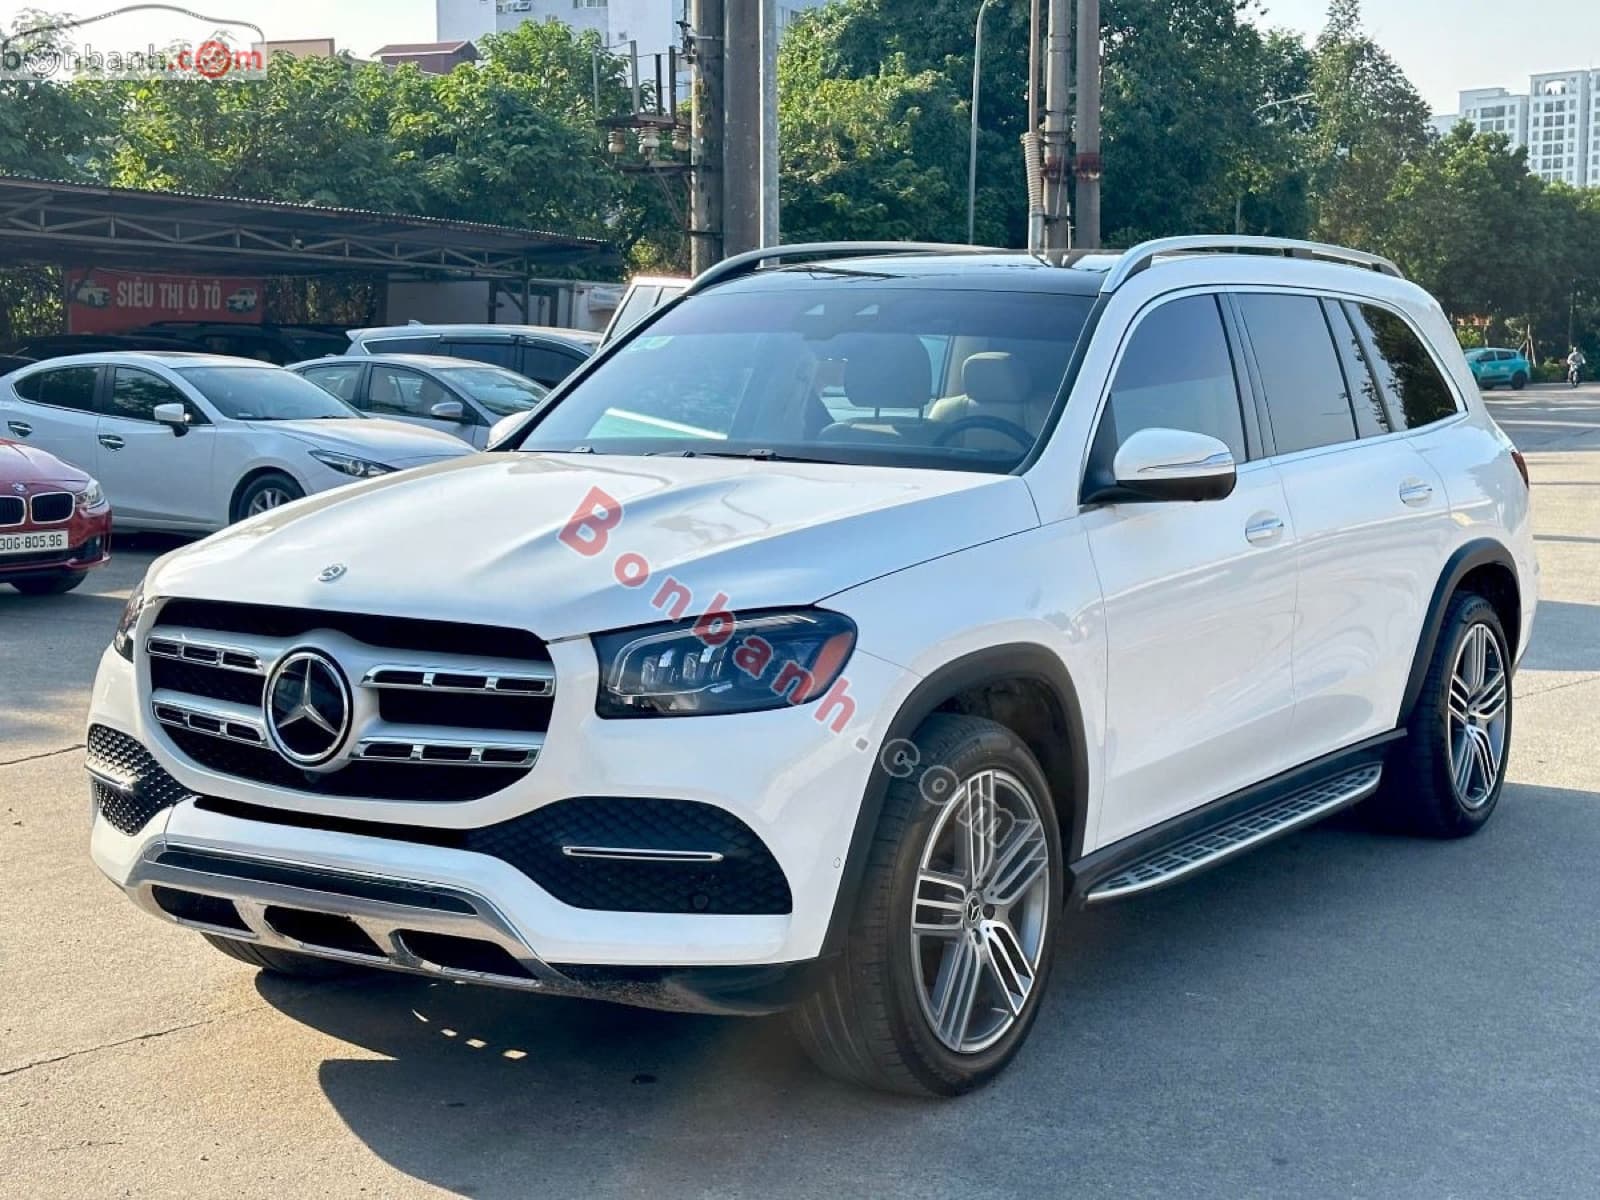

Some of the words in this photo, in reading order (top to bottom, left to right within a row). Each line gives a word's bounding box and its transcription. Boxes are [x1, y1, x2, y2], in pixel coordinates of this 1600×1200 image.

[116, 277, 154, 307] SIÊU
[159, 283, 184, 315] THỊ
[188, 278, 198, 308] Ô
[203, 280, 221, 310] TÔ
